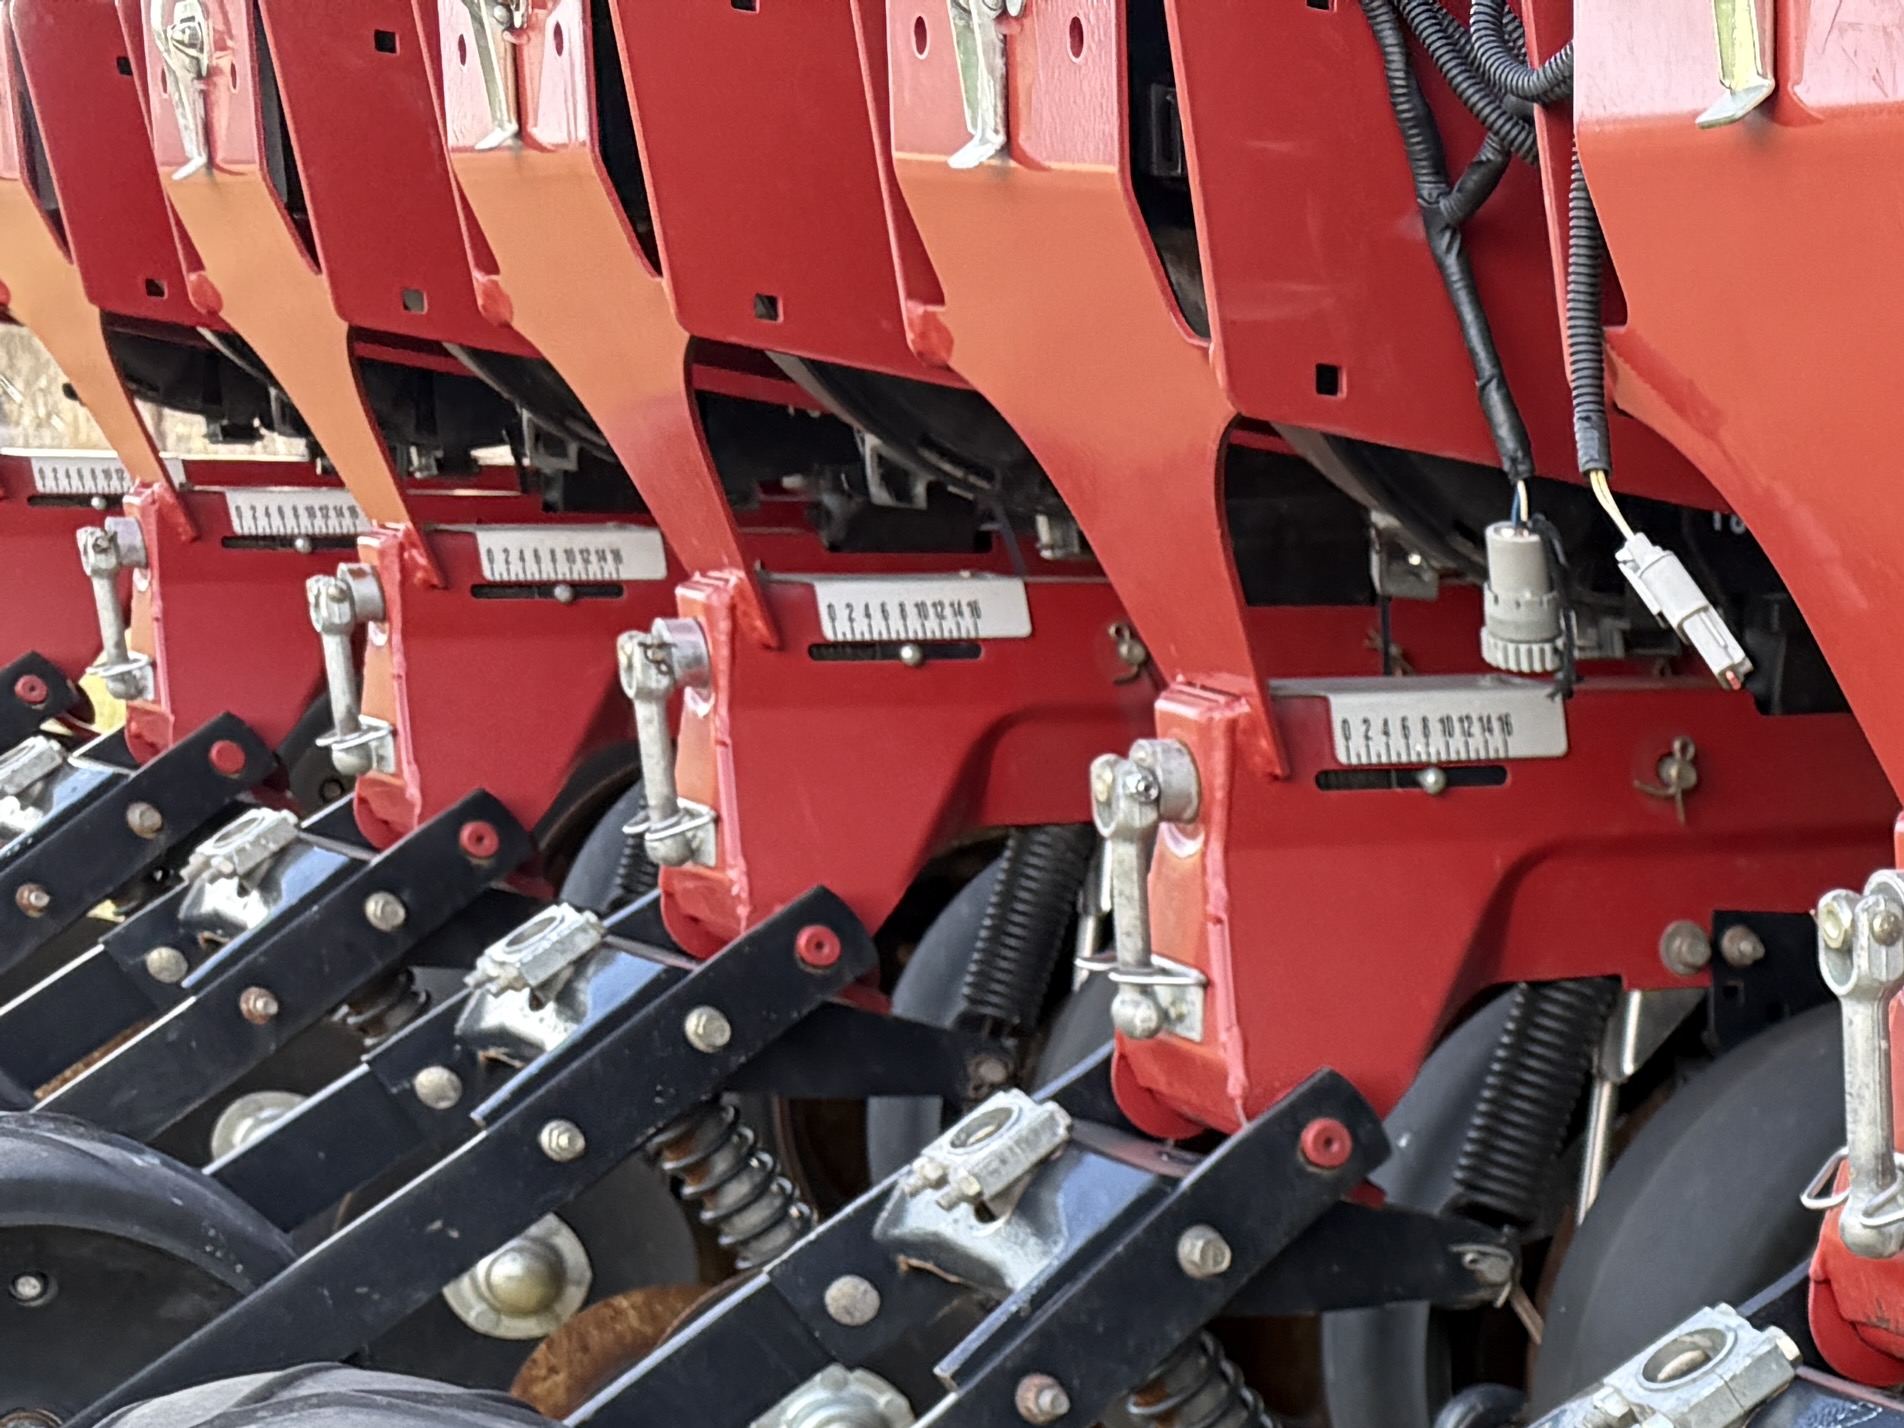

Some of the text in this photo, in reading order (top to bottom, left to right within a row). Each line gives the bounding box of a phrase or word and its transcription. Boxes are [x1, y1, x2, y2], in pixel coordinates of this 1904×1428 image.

[503, 547, 510, 565] 2
[846, 602, 855, 622] 2
[864, 601, 871, 619] 4
[914, 600, 929, 621] 10
[931, 600, 945, 620] 12
[949, 599, 964, 618] 14
[1341, 718, 1350, 741] 0
[1363, 717, 1371, 741] 2
[1382, 717, 1390, 738] 4
[1401, 716, 1410, 740] 6
[1439, 714, 1454, 738] 10
[1459, 714, 1474, 738] 12
[1479, 713, 1494, 736] 14
[1498, 713, 1513, 737] 16
